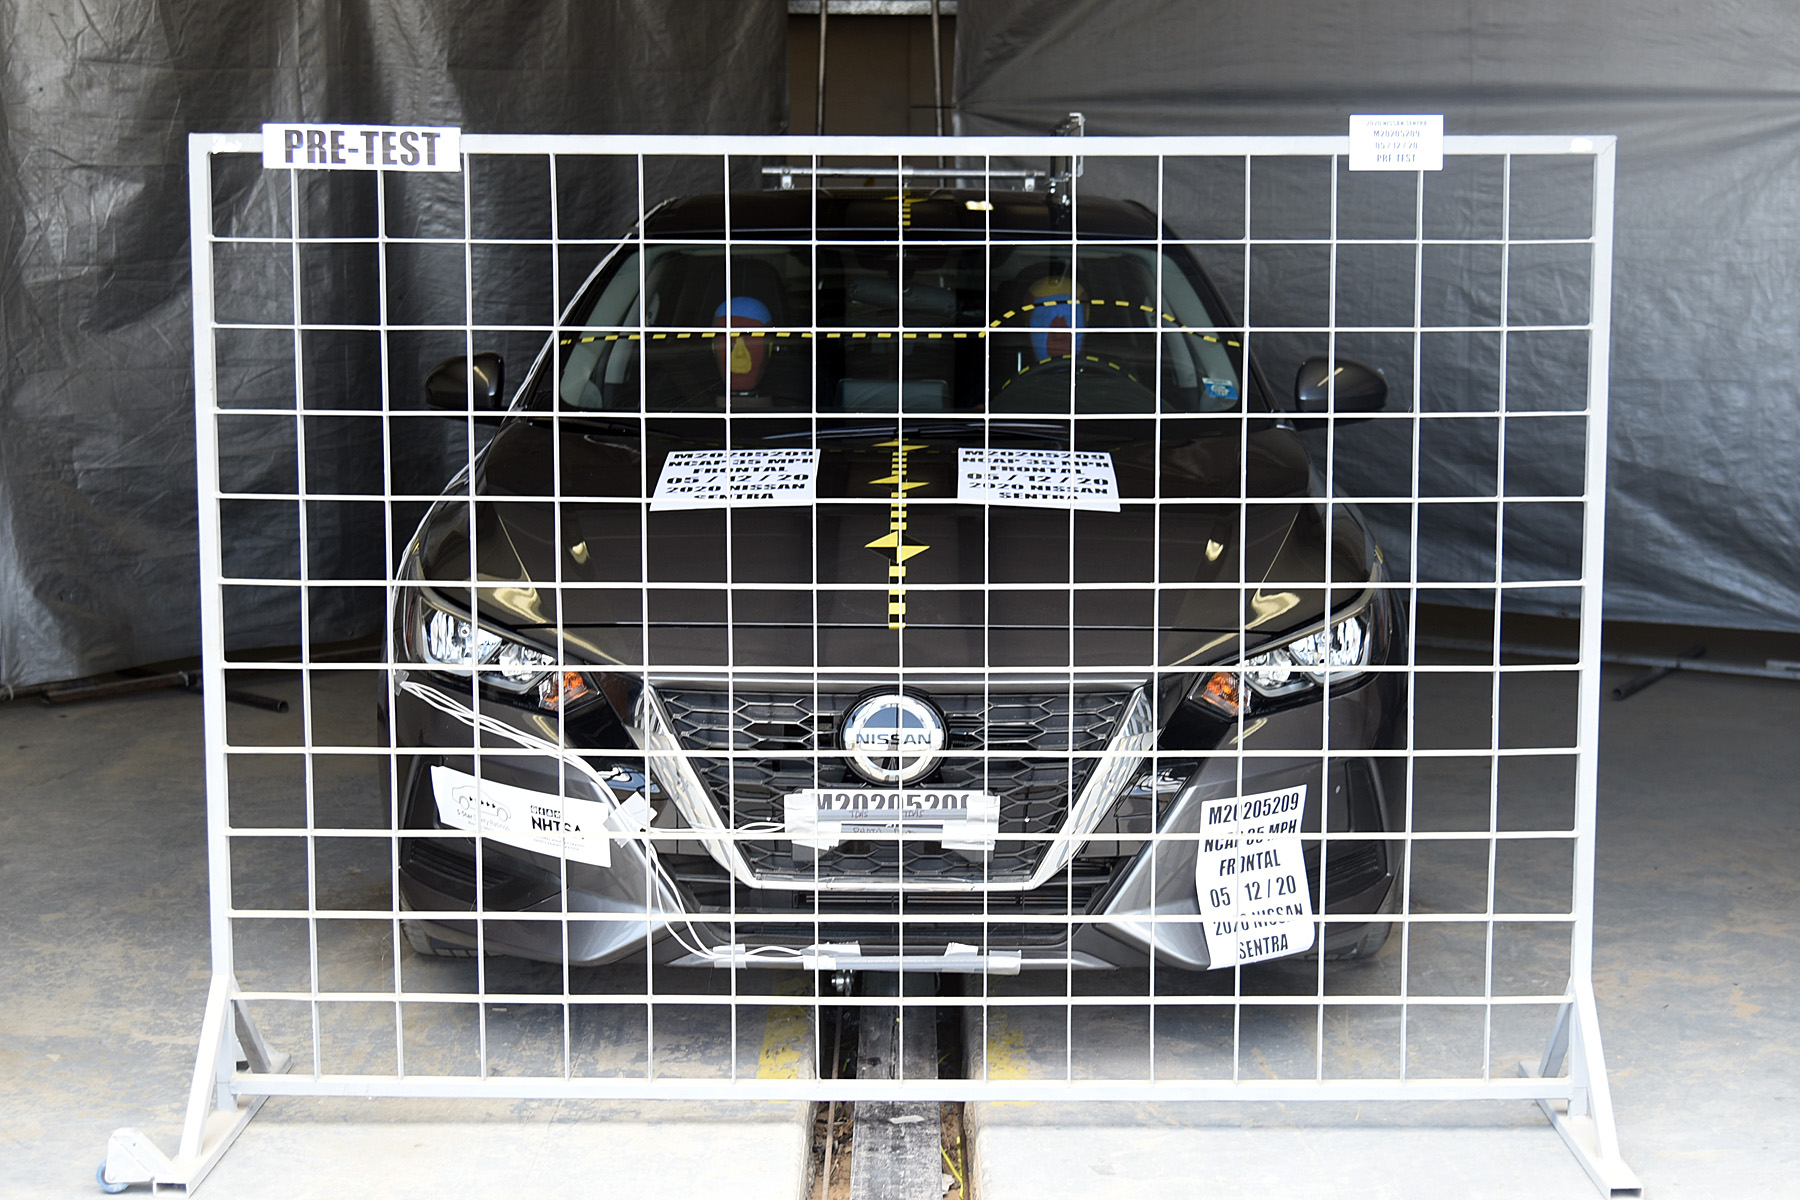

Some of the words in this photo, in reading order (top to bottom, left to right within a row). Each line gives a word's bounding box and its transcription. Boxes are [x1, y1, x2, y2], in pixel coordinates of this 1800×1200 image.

[284, 129, 441, 166] PRE-TEST
[1397, 154, 1416, 162] TEST
[730, 483, 805, 491] NISSAN
[1031, 485, 1107, 494] NISSAN
[856, 733, 931, 745] NISSAN
[1268, 819, 1298, 841] MPH
[1210, 887, 1231, 908] 05
[1244, 881, 1262, 901] 12
[1276, 875, 1296, 896] 20
[1239, 934, 1288, 959] SENTRA
